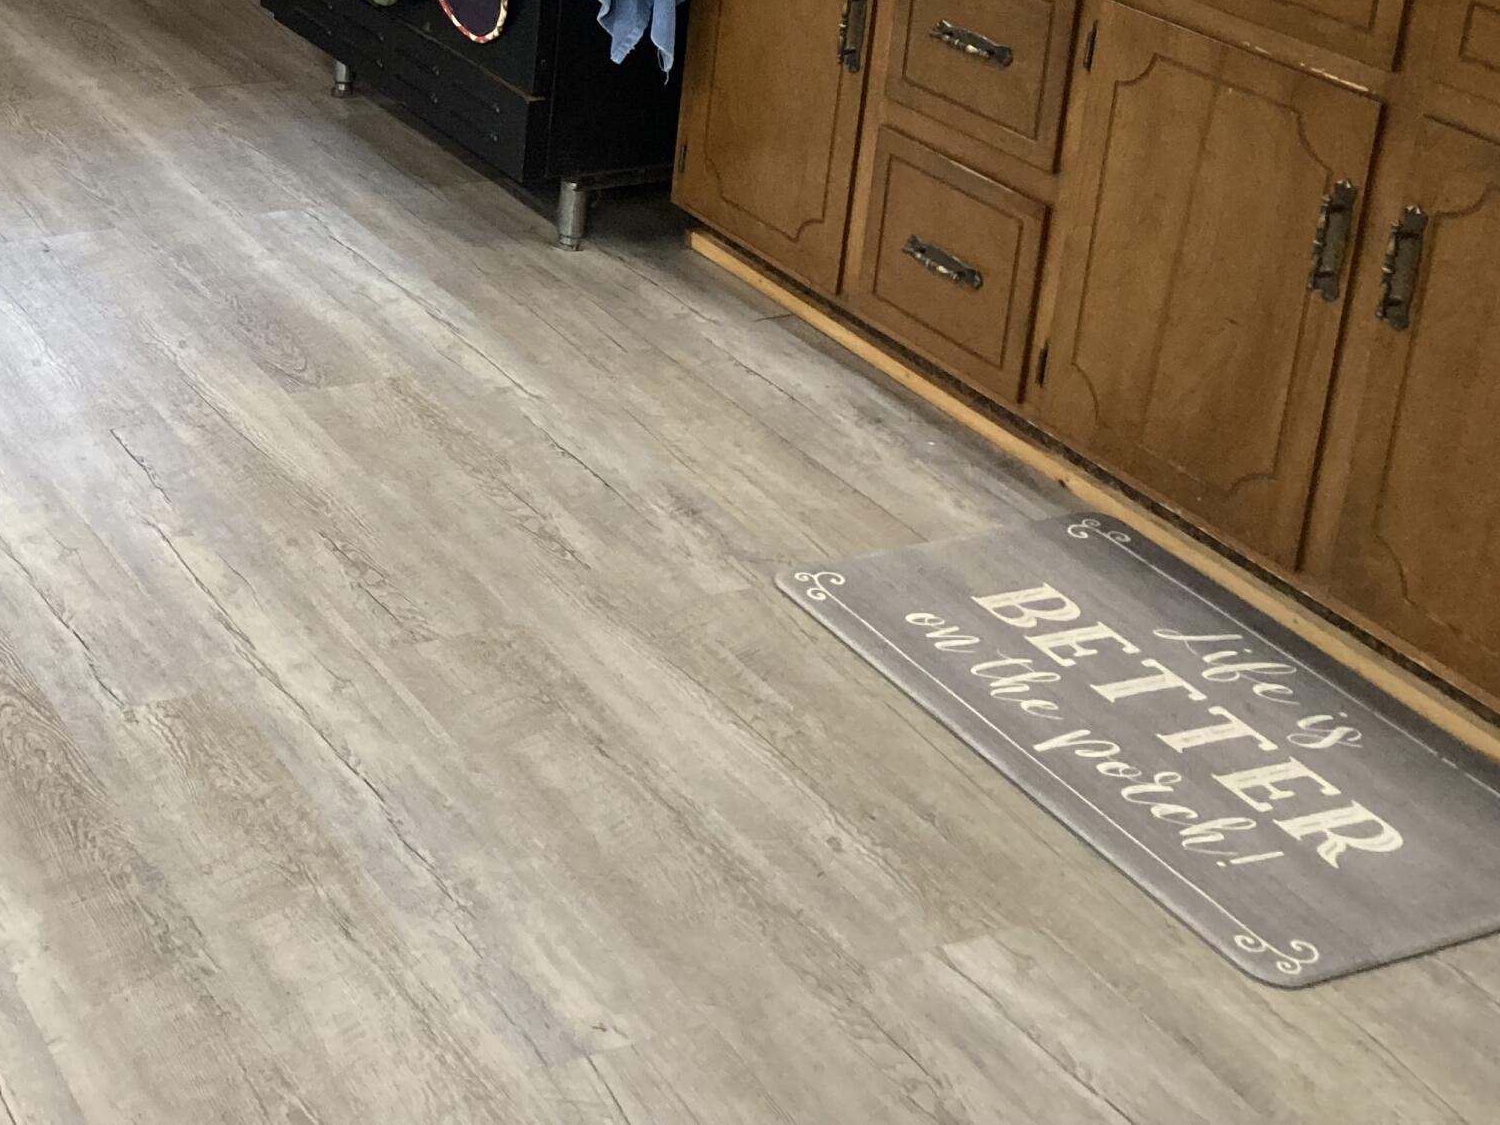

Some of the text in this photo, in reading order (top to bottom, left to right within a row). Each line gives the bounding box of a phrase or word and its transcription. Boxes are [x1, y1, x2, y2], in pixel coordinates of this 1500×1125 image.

[904, 612, 1285, 868] on the porch!
[970, 581, 1404, 869] BETTER
[1153, 628, 1364, 750] Life is
